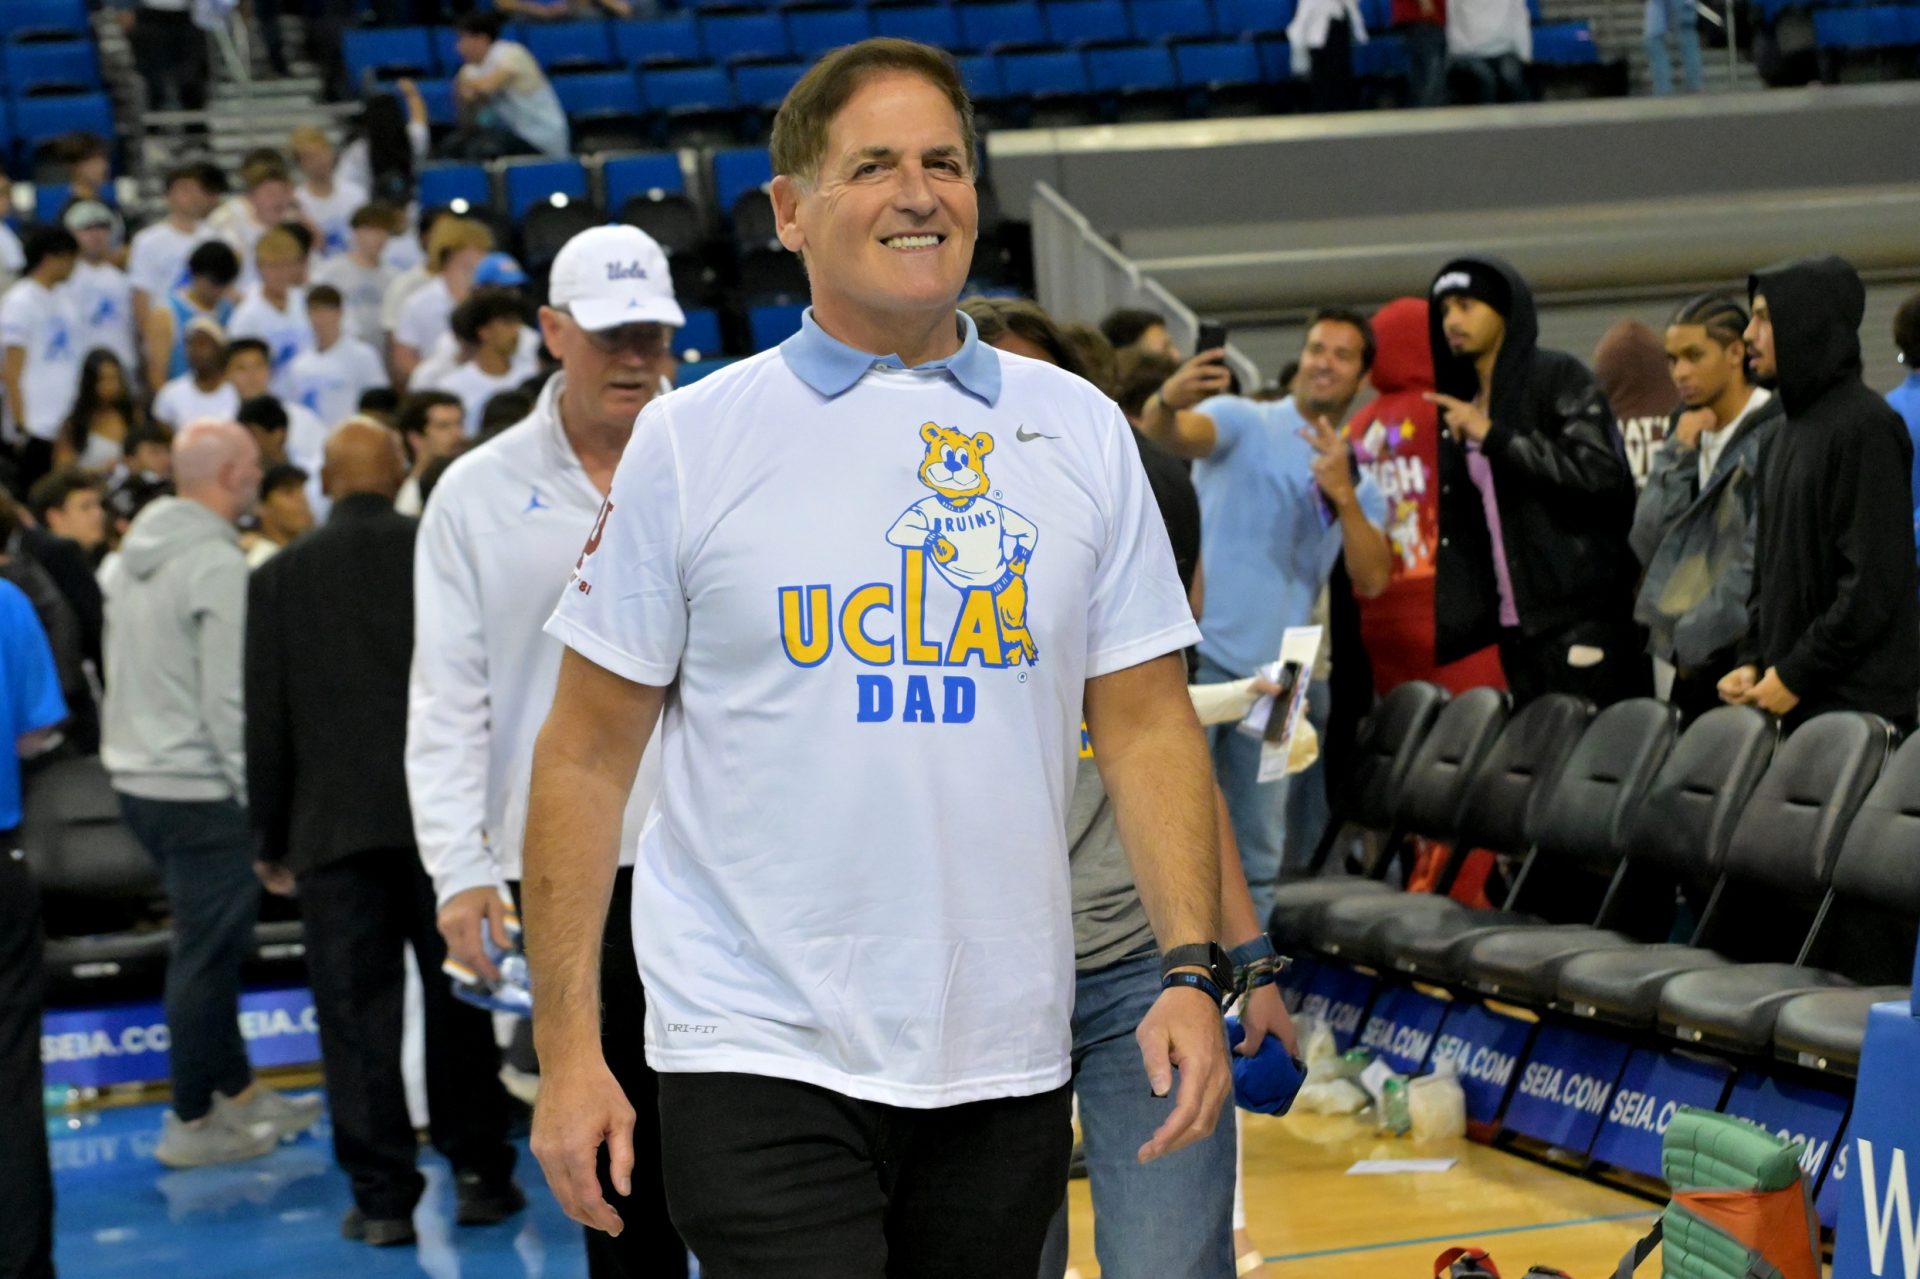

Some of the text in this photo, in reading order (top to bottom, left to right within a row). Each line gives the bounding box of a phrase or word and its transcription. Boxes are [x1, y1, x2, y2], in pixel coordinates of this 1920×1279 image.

[934, 509, 996, 535] BRUINS
[777, 547, 1008, 669] UCLA
[856, 674, 976, 724] DAD
[41, 1023, 171, 1063] SEIA.CO
[667, 1023, 718, 1034] DRI-FIT
[1361, 1016, 1433, 1063] SEIA.COM
[1431, 1034, 1516, 1087] SEIA.COM
[1520, 1062, 1612, 1116] SEIA.COM
[1609, 1089, 1677, 1136] SEIA.C
